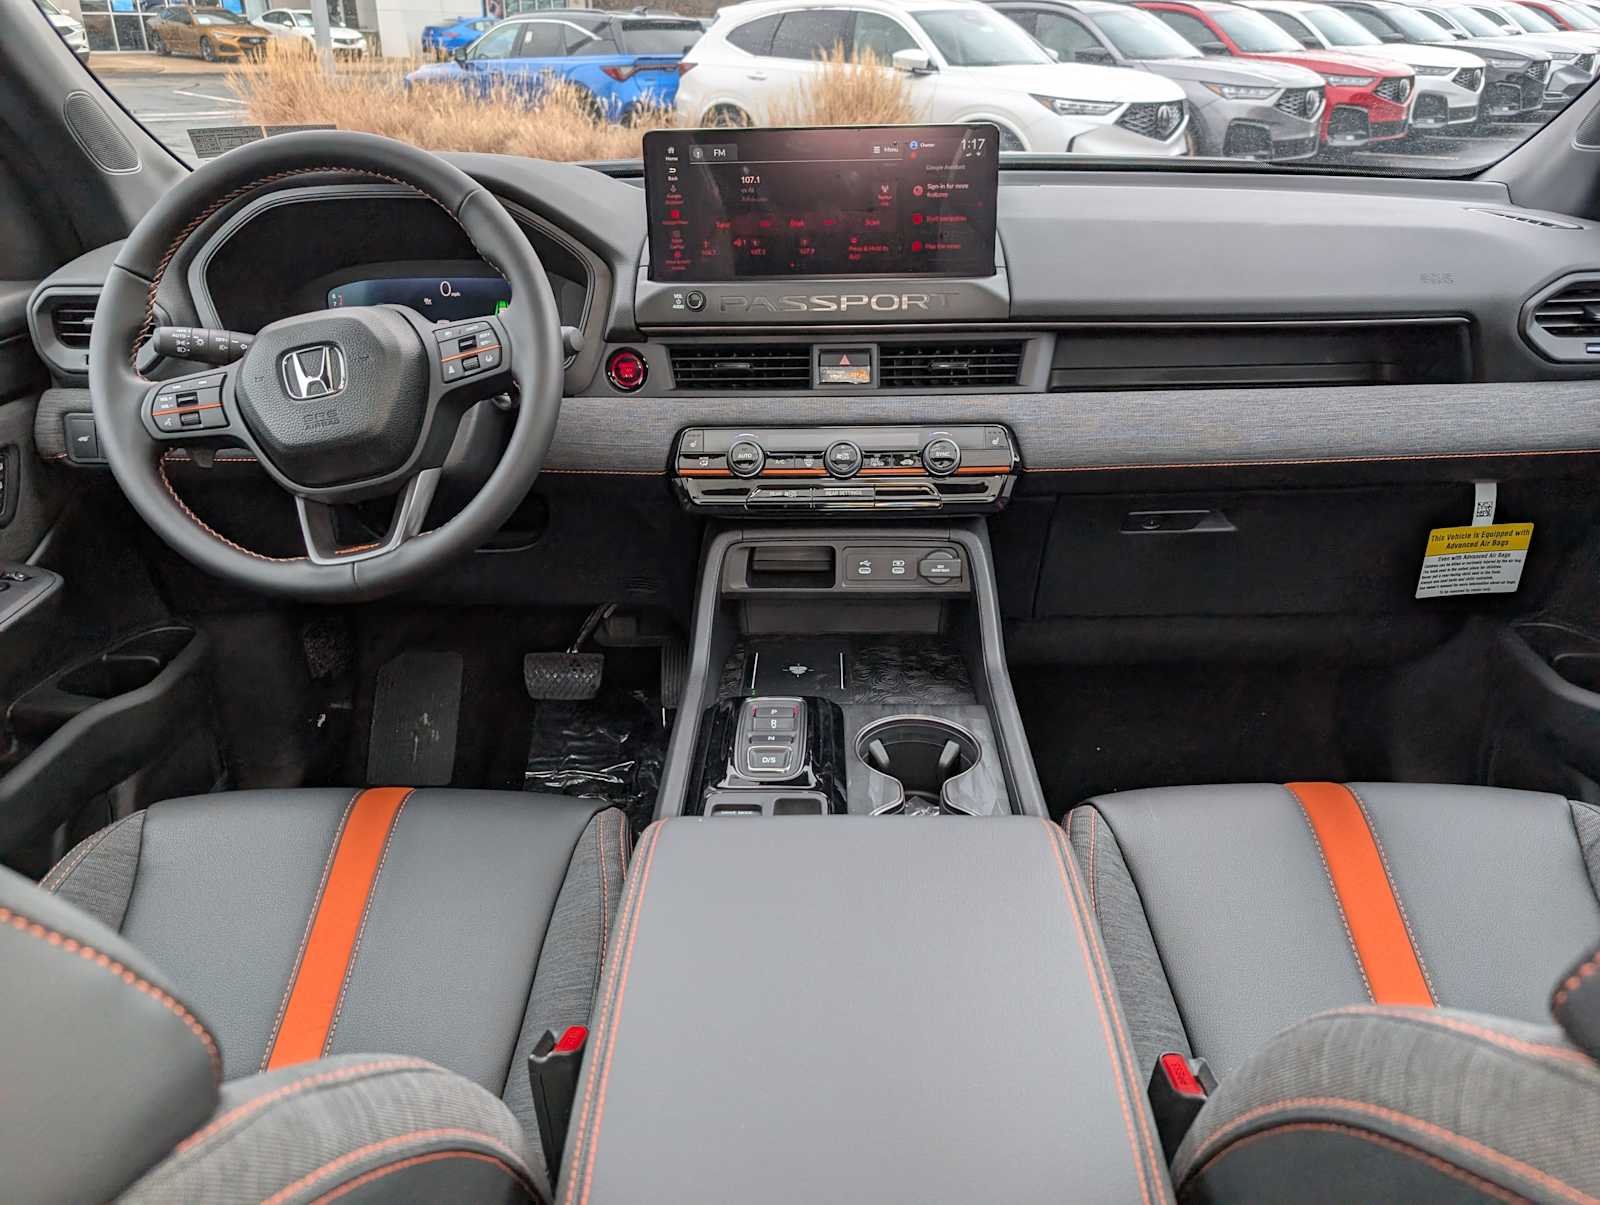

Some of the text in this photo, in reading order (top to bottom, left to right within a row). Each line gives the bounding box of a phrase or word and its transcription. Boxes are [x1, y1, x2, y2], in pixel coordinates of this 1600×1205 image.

[960, 137, 986, 150] 1:17
[713, 148, 727, 157] FM
[741, 176, 761, 184] 107.1
[440, 280, 451, 297] 0
[719, 291, 959, 312] PASSPORT
[1447, 533, 1472, 541] Vehicle
[1481, 530, 1513, 539] Equipped
[1515, 528, 1529, 536] with
[1446, 541, 1478, 549] Advanced
